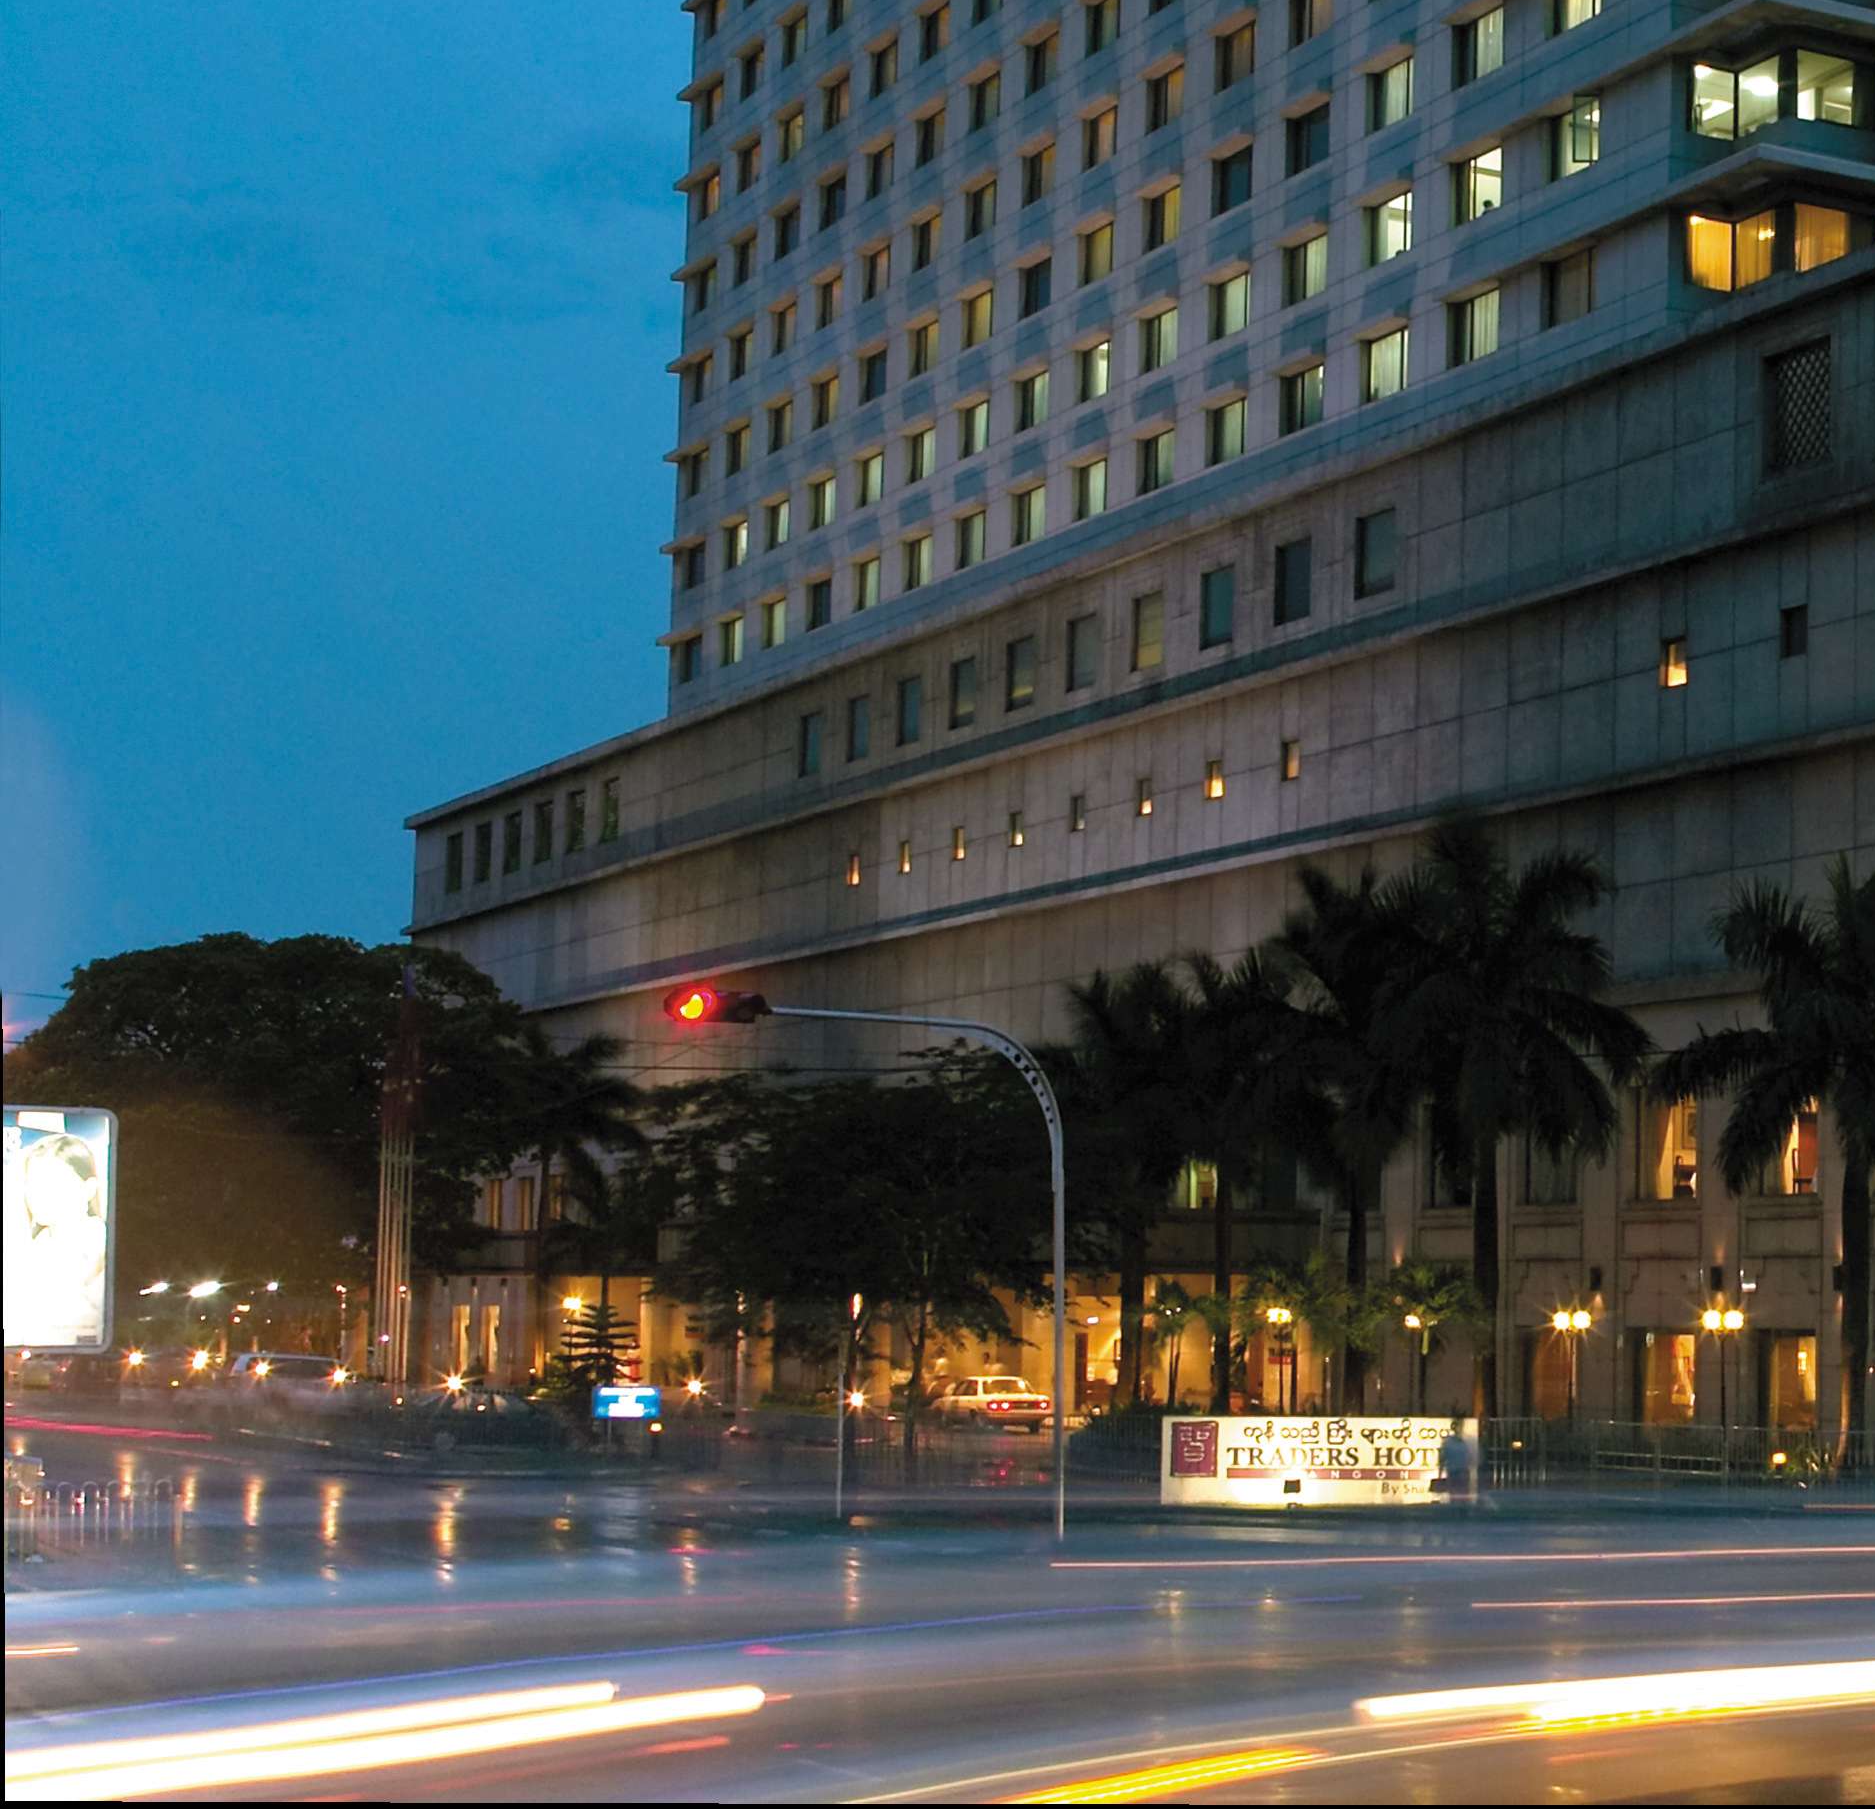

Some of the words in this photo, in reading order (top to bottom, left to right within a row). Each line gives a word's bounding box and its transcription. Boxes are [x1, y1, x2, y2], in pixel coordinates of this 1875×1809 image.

[1226, 1447, 1359, 1467] TRADERS
[1373, 1447, 1441, 1467] HOT
[1308, 1470, 1409, 1480] ANGON
